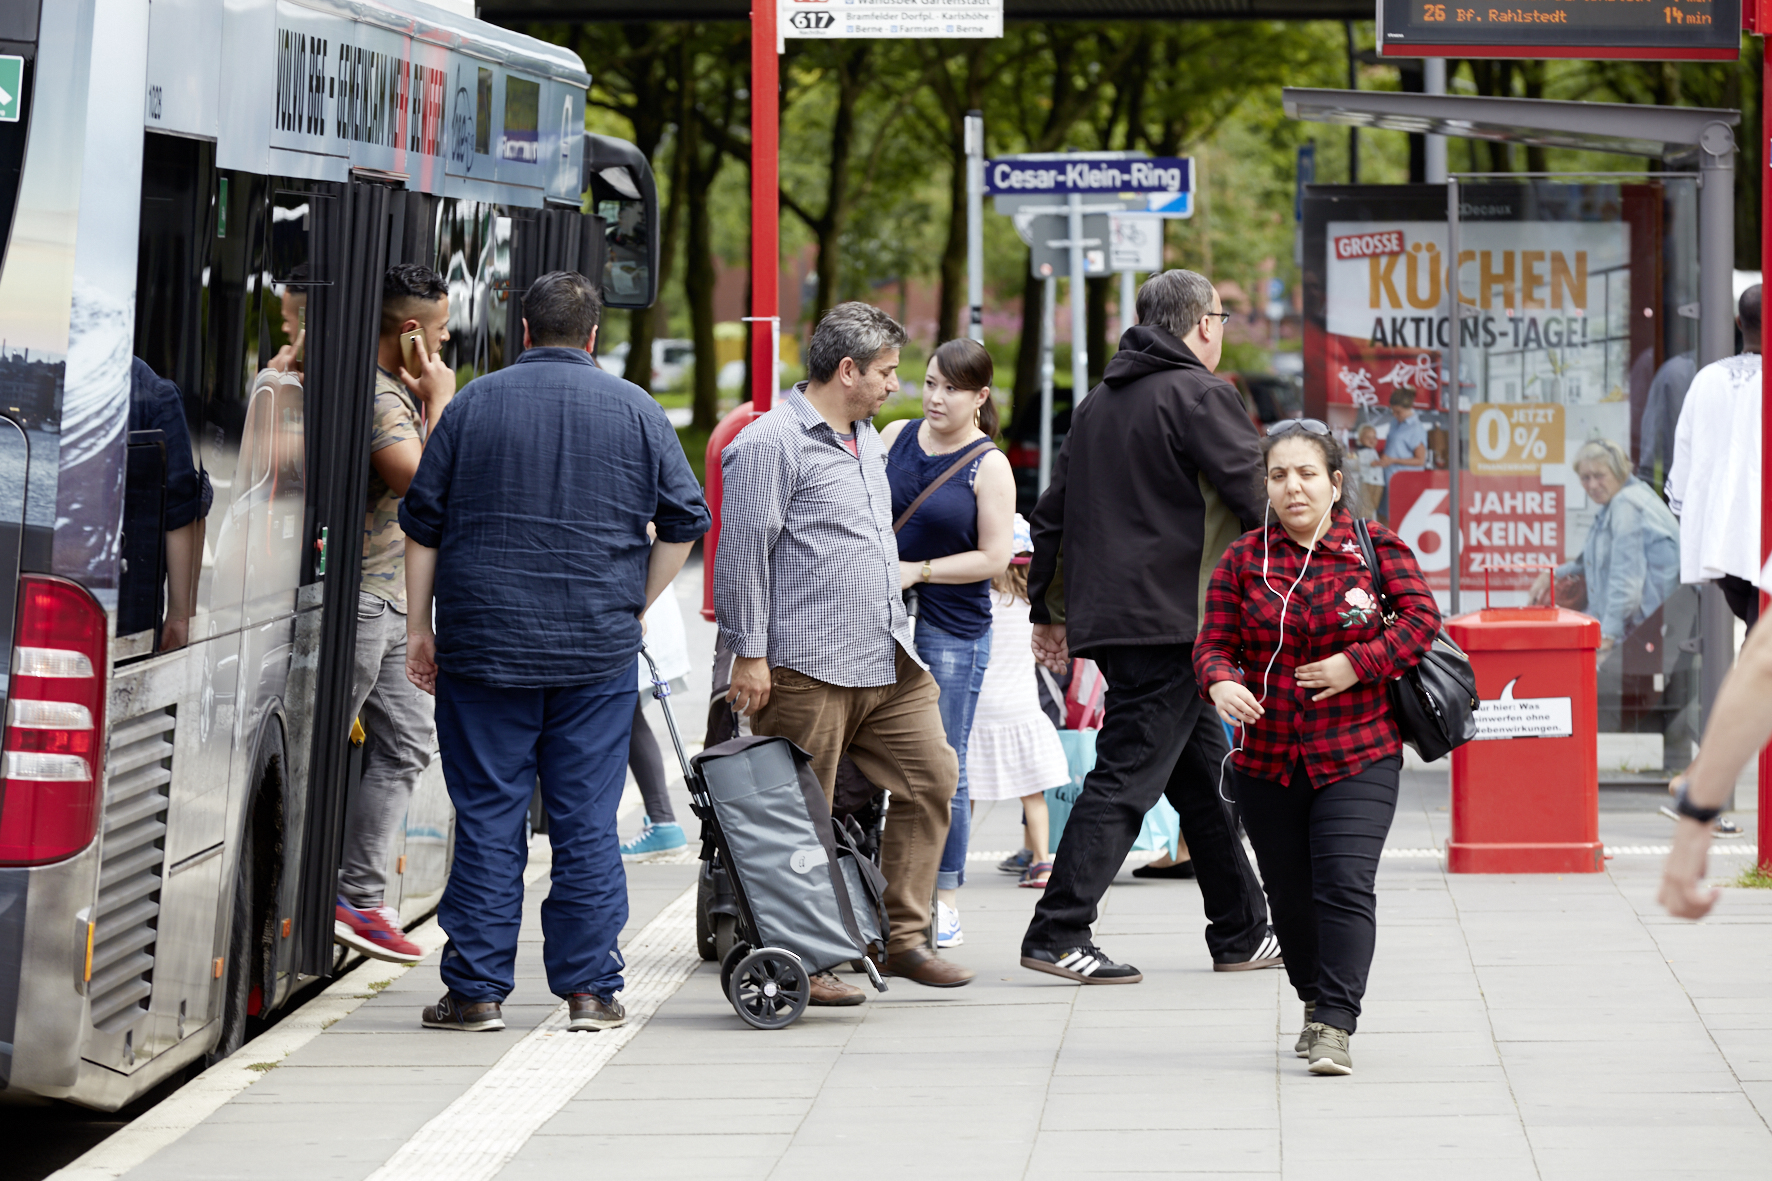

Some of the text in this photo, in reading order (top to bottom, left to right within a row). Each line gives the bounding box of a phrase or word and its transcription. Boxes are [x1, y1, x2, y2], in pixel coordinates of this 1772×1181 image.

[794, 12, 830, 28] 617
[846, 12, 898, 20] Bramfelder
[901, 12, 935, 22] Dorfpl.
[942, 12, 989, 20] Karlshöhe
[1424, 4, 1712, 24] 26 Bf. Rahlstedt 14 min
[856, 25, 882, 33] Berne
[900, 25, 939, 33] Farmsen
[956, 25, 983, 33] Berne
[276, 28, 305, 133] VOLVO
[336, 43, 387, 146] GEMEINSAM
[387, 56, 410, 150] MEHR
[994, 162, 1181, 192] Cesar-Klein-Ring
[1444, 203, 1512, 216] Decaux
[1338, 232, 1401, 257] GROSSE
[1369, 241, 1587, 309] KÜCHEN
[1370, 316, 1588, 348] AKTIONS-TAGE!
[1511, 408, 1555, 423] JETZT
[1468, 491, 1557, 514] JAHRE
[1397, 489, 1464, 572] 6
[1469, 521, 1557, 546] KEINE
[1468, 552, 1557, 573] ZINSEN
[1477, 704, 1490, 712] ur
